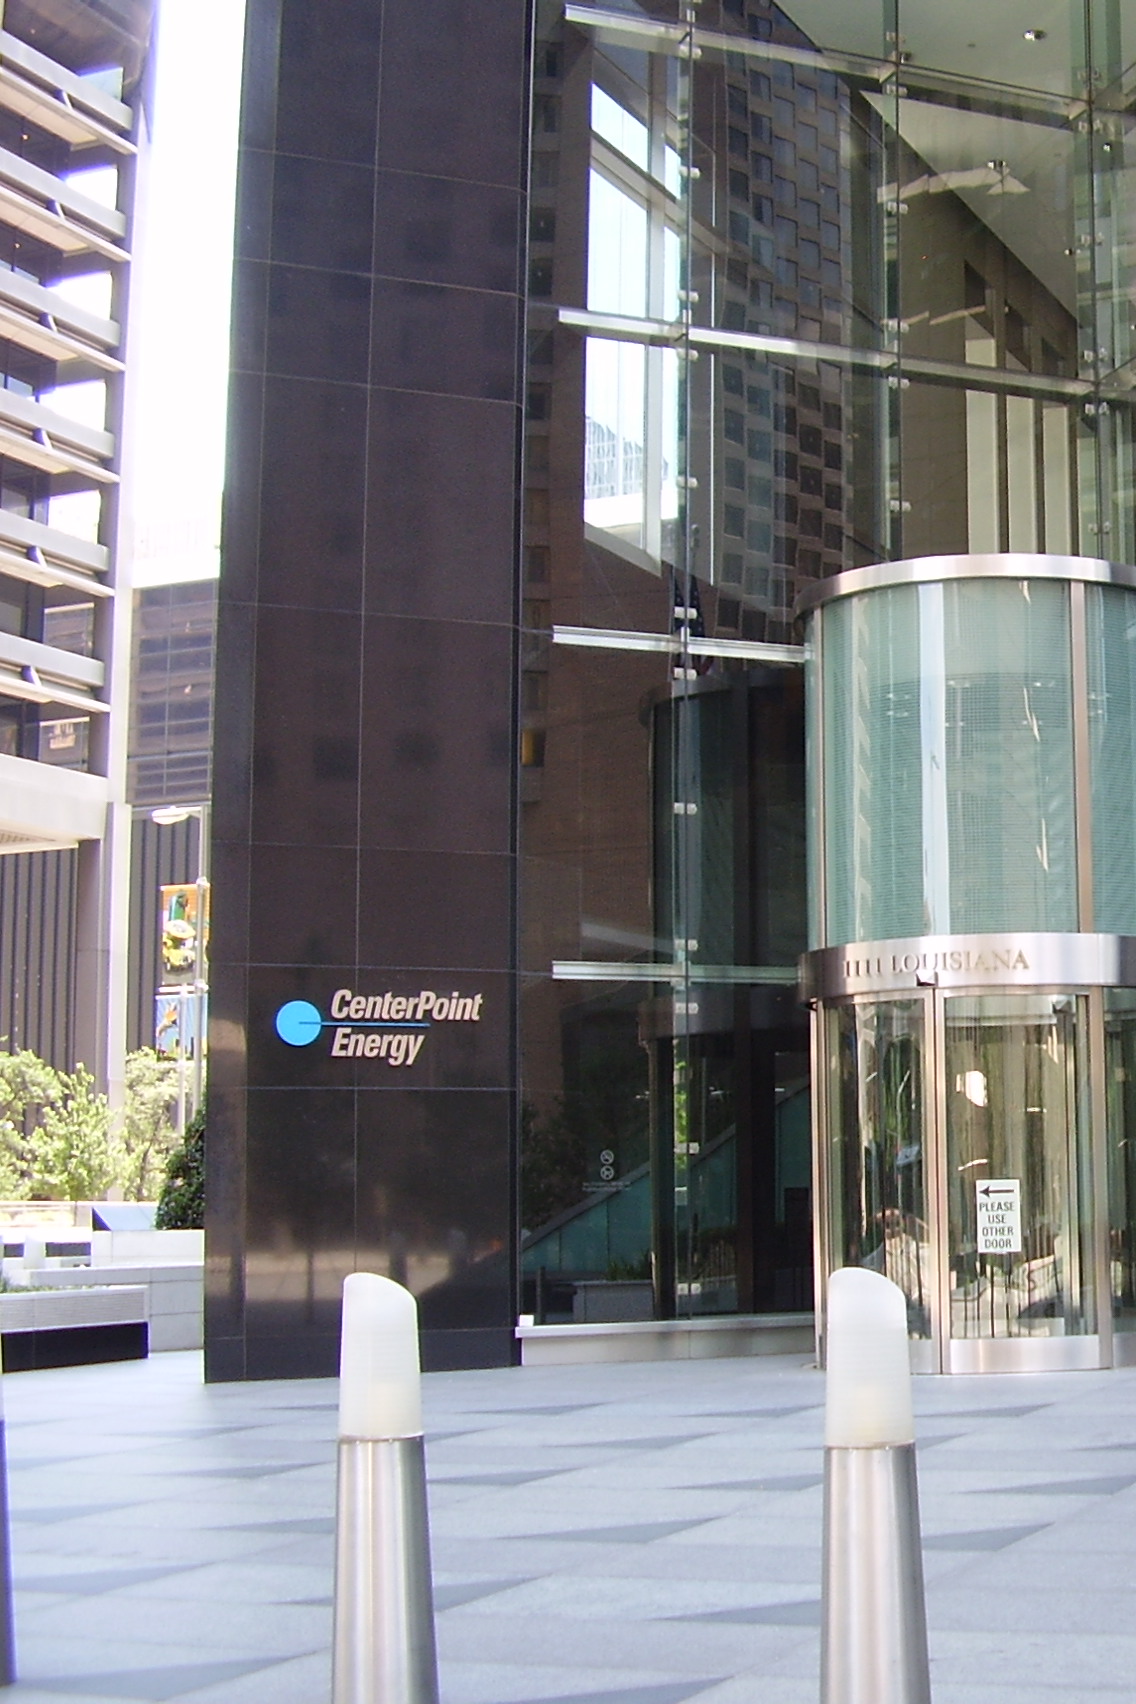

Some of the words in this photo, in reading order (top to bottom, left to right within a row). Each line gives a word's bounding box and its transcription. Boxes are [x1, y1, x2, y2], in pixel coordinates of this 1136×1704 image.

[891, 949, 1030, 974] LOUISIANA
[331, 988, 483, 1021] CenterPoint
[331, 1027, 425, 1066] Energy
[979, 1201, 1015, 1212] PLEASE
[988, 1214, 1006, 1224] USE
[982, 1226, 1014, 1237] OTHER
[984, 1238, 1012, 1249] DOOR
